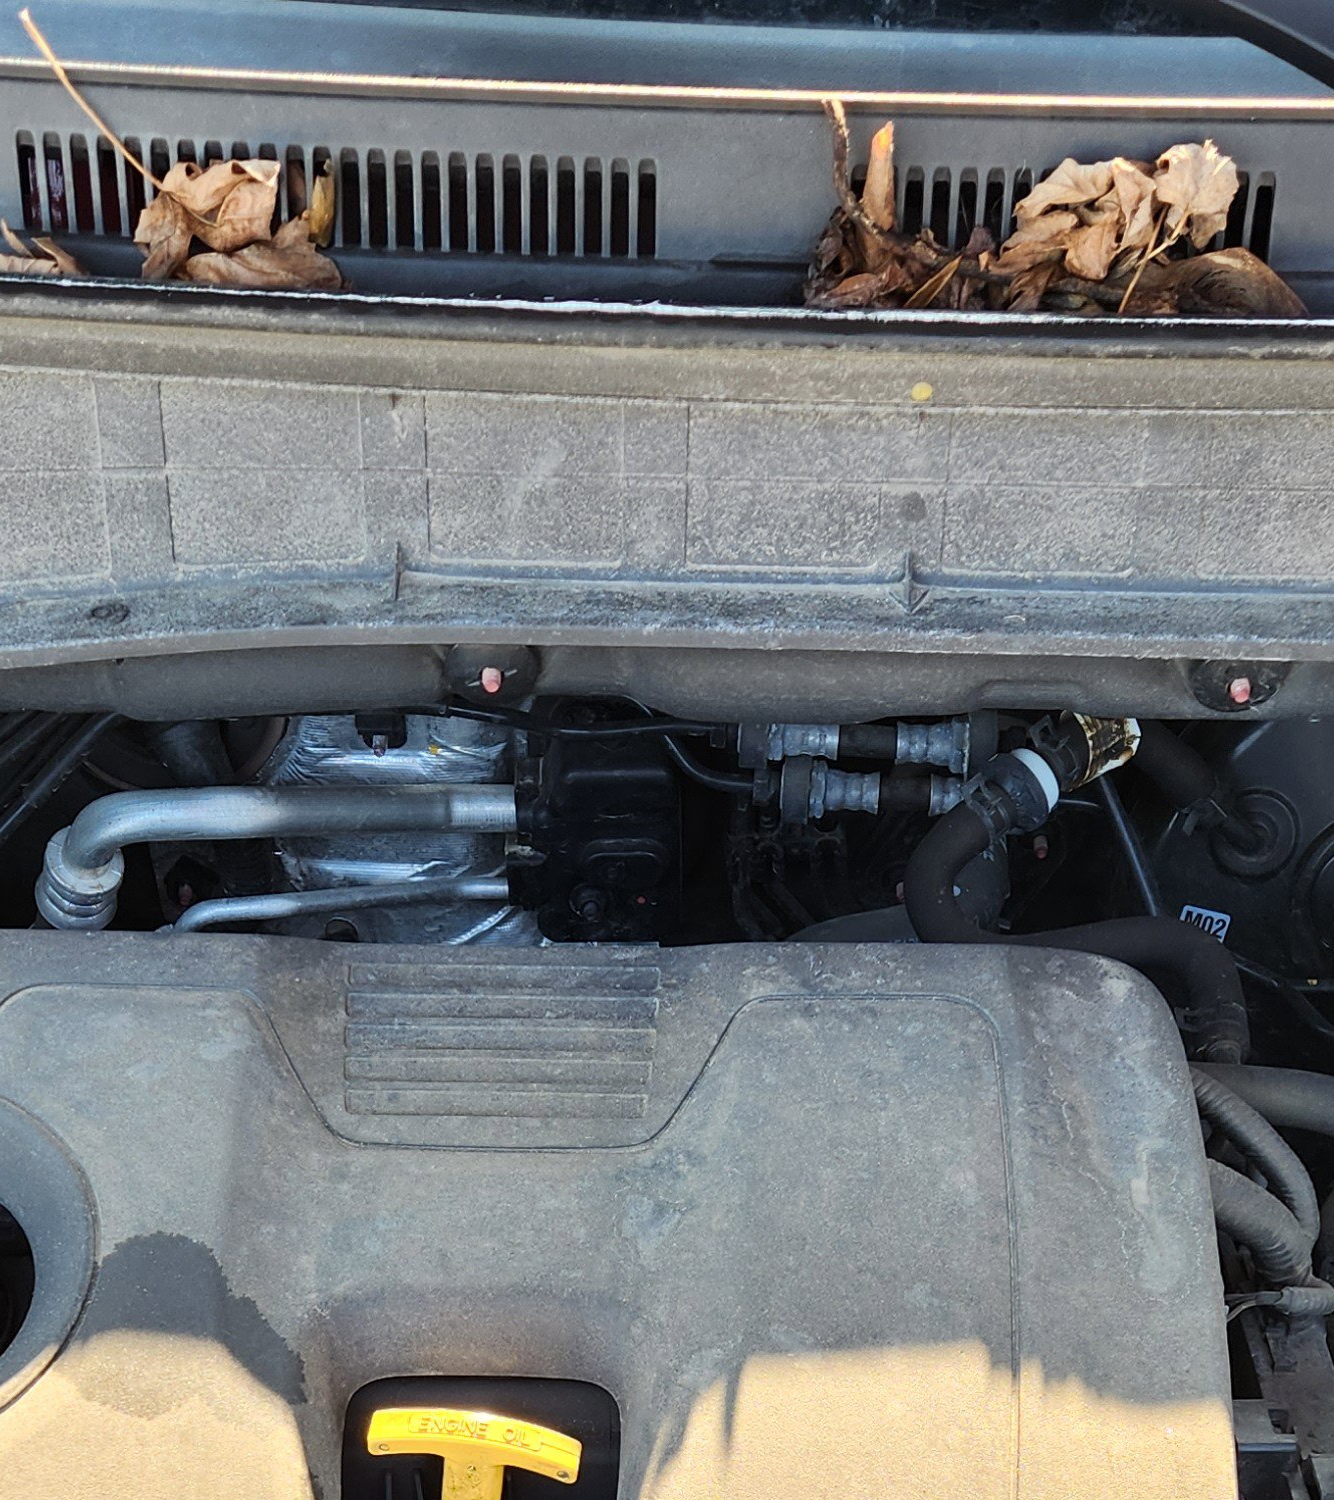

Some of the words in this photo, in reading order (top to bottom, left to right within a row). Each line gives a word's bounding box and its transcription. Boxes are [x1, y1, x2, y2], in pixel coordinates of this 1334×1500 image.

[1184, 910, 1227, 939] M02
[418, 1416, 489, 1439] ENGINE
[502, 1428, 531, 1448] OIL
